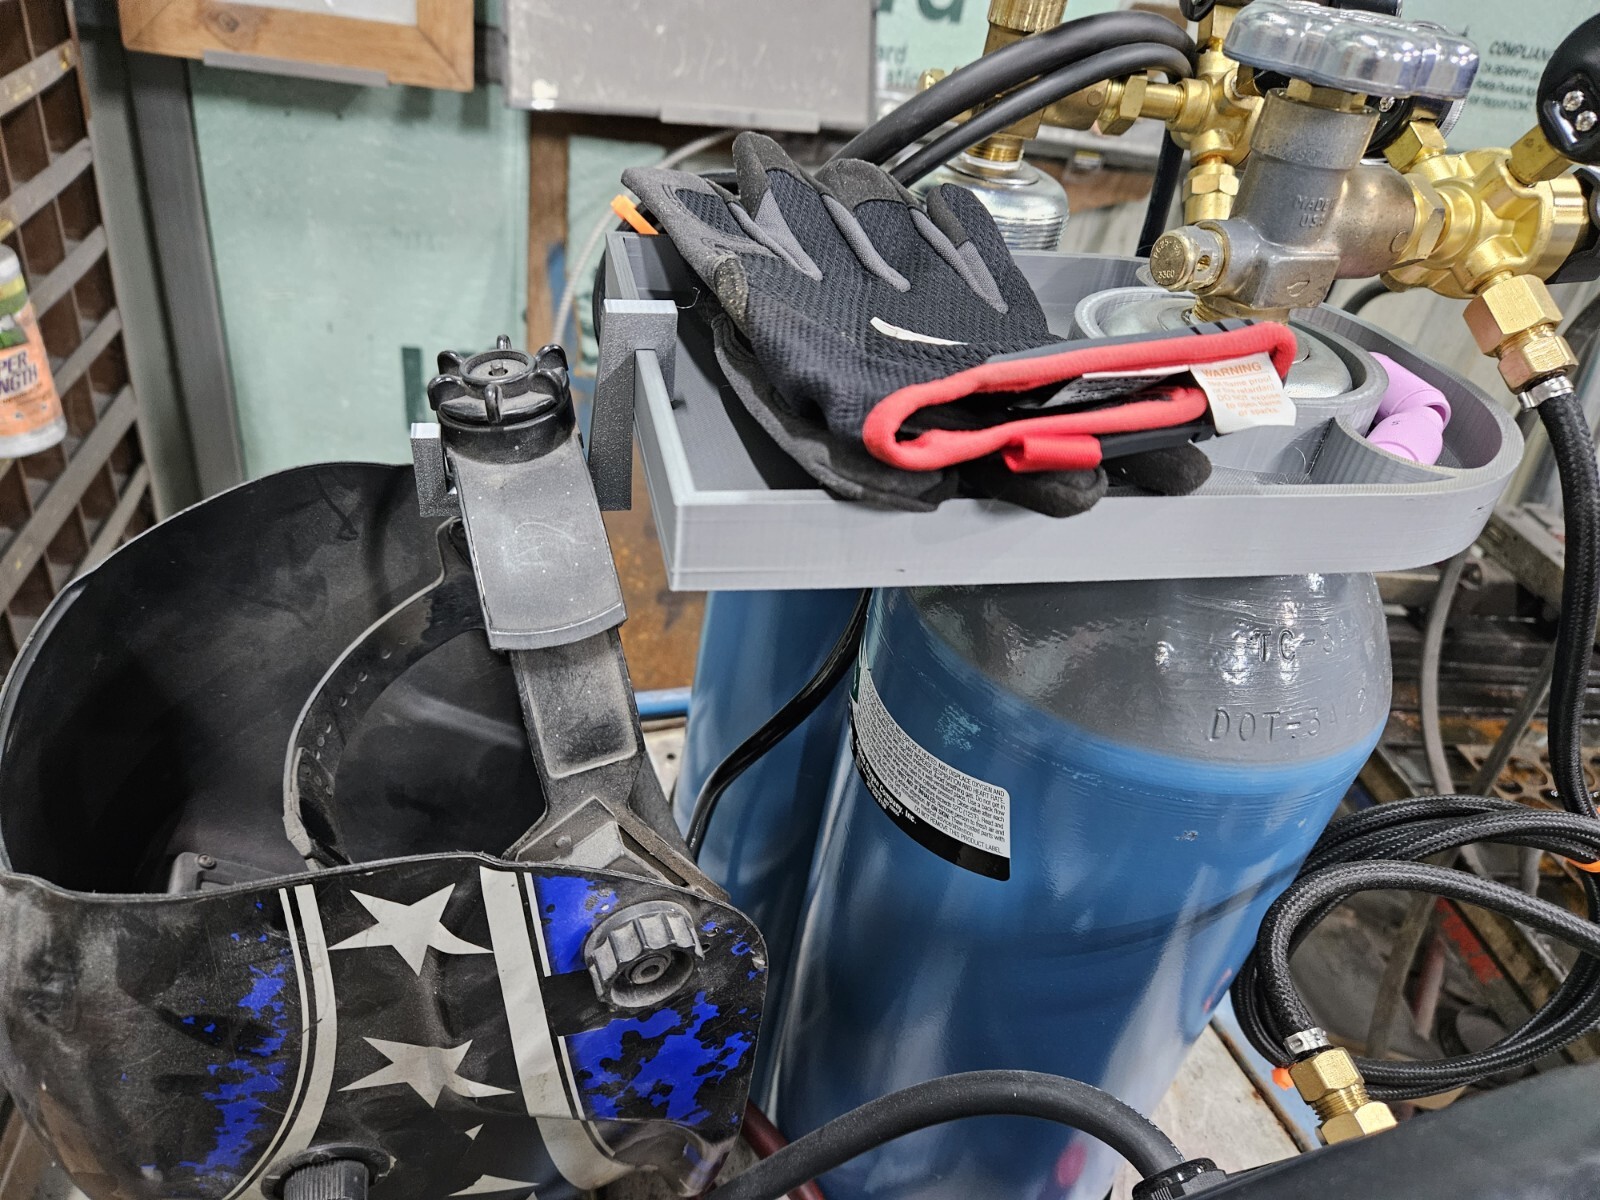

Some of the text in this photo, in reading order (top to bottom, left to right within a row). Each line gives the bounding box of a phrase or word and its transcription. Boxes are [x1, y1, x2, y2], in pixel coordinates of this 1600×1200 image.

[0, 351, 27, 373] PER
[1202, 362, 1261, 377] WARNING
[0, 363, 38, 395] NGTH
[905, 809, 917, 824] Inc.
